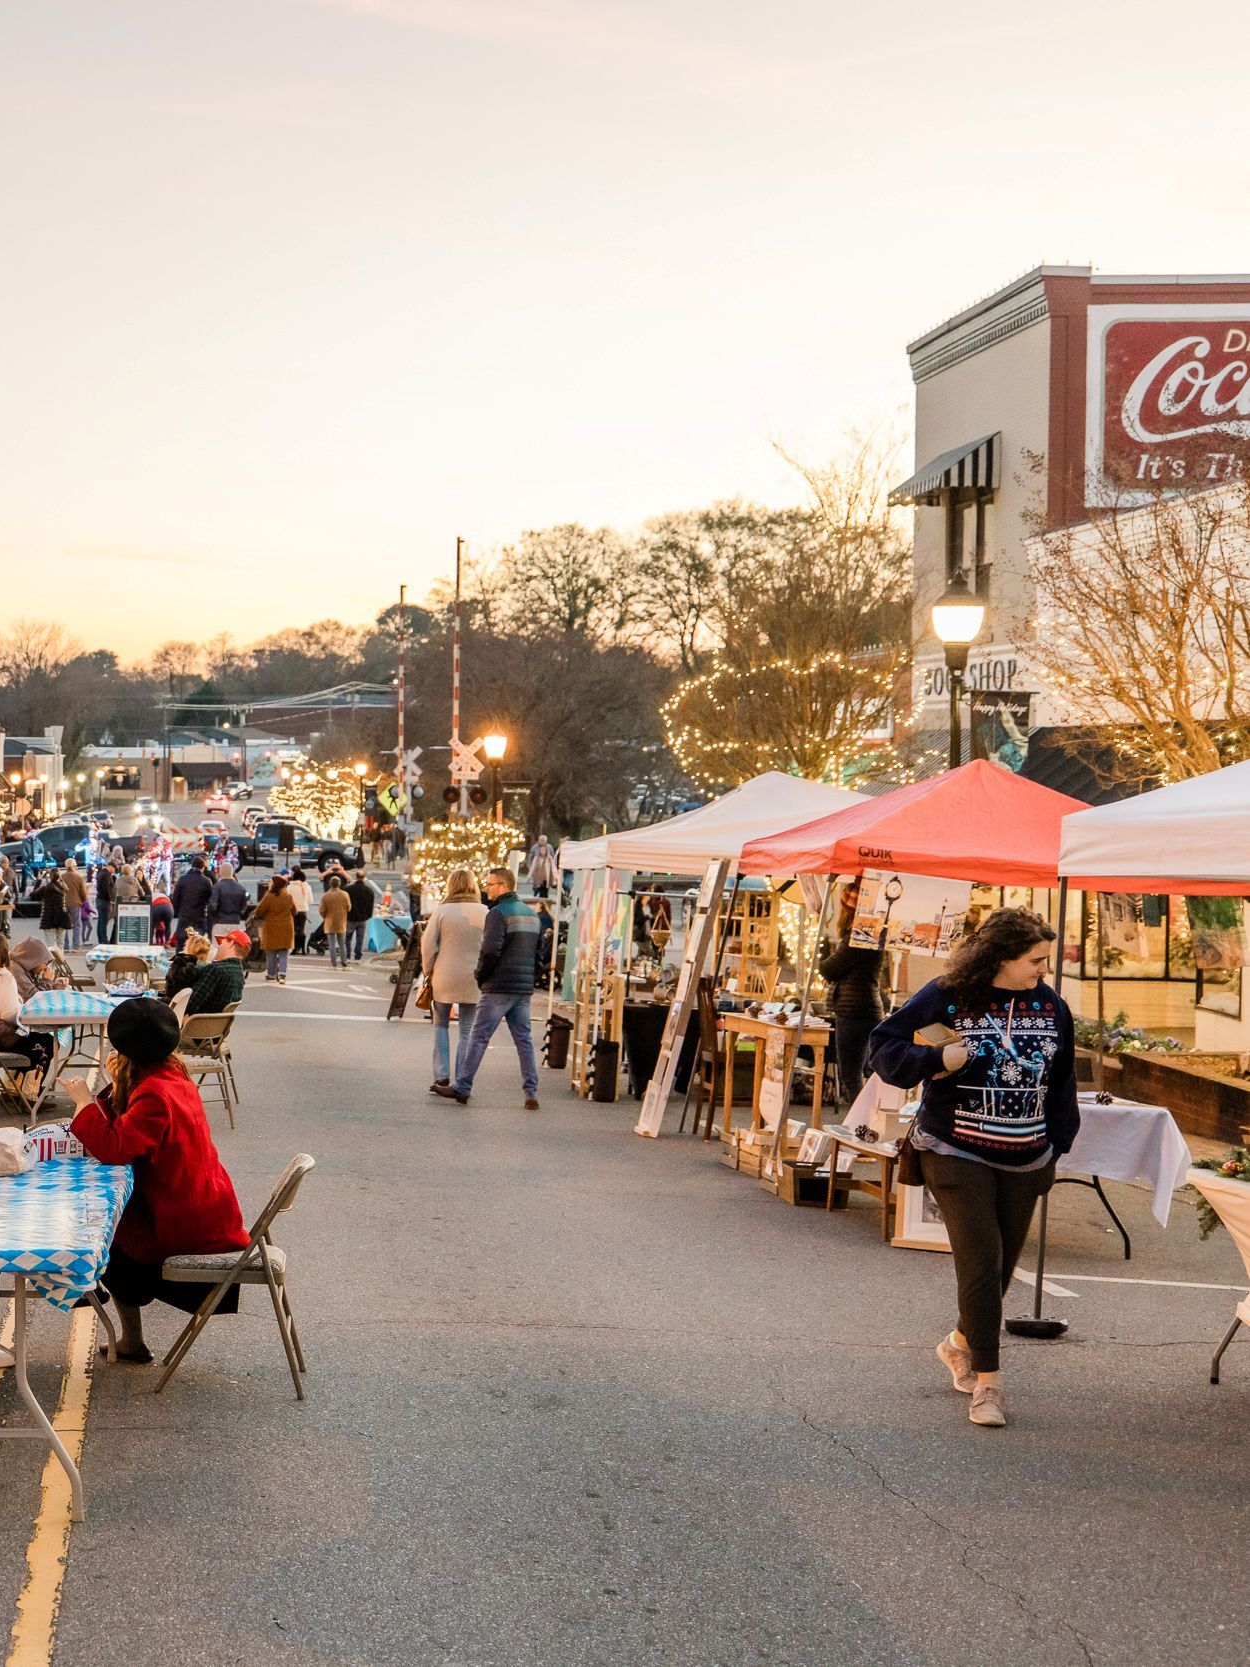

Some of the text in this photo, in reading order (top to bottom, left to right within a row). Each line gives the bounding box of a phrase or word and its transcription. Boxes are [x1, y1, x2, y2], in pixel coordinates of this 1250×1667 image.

[1223, 329, 1250, 352] D
[1136, 454, 1186, 479] It's
[970, 659, 1017, 691] SHOP
[973, 701, 995, 716] Happy
[858, 846, 893, 859] QUIK
